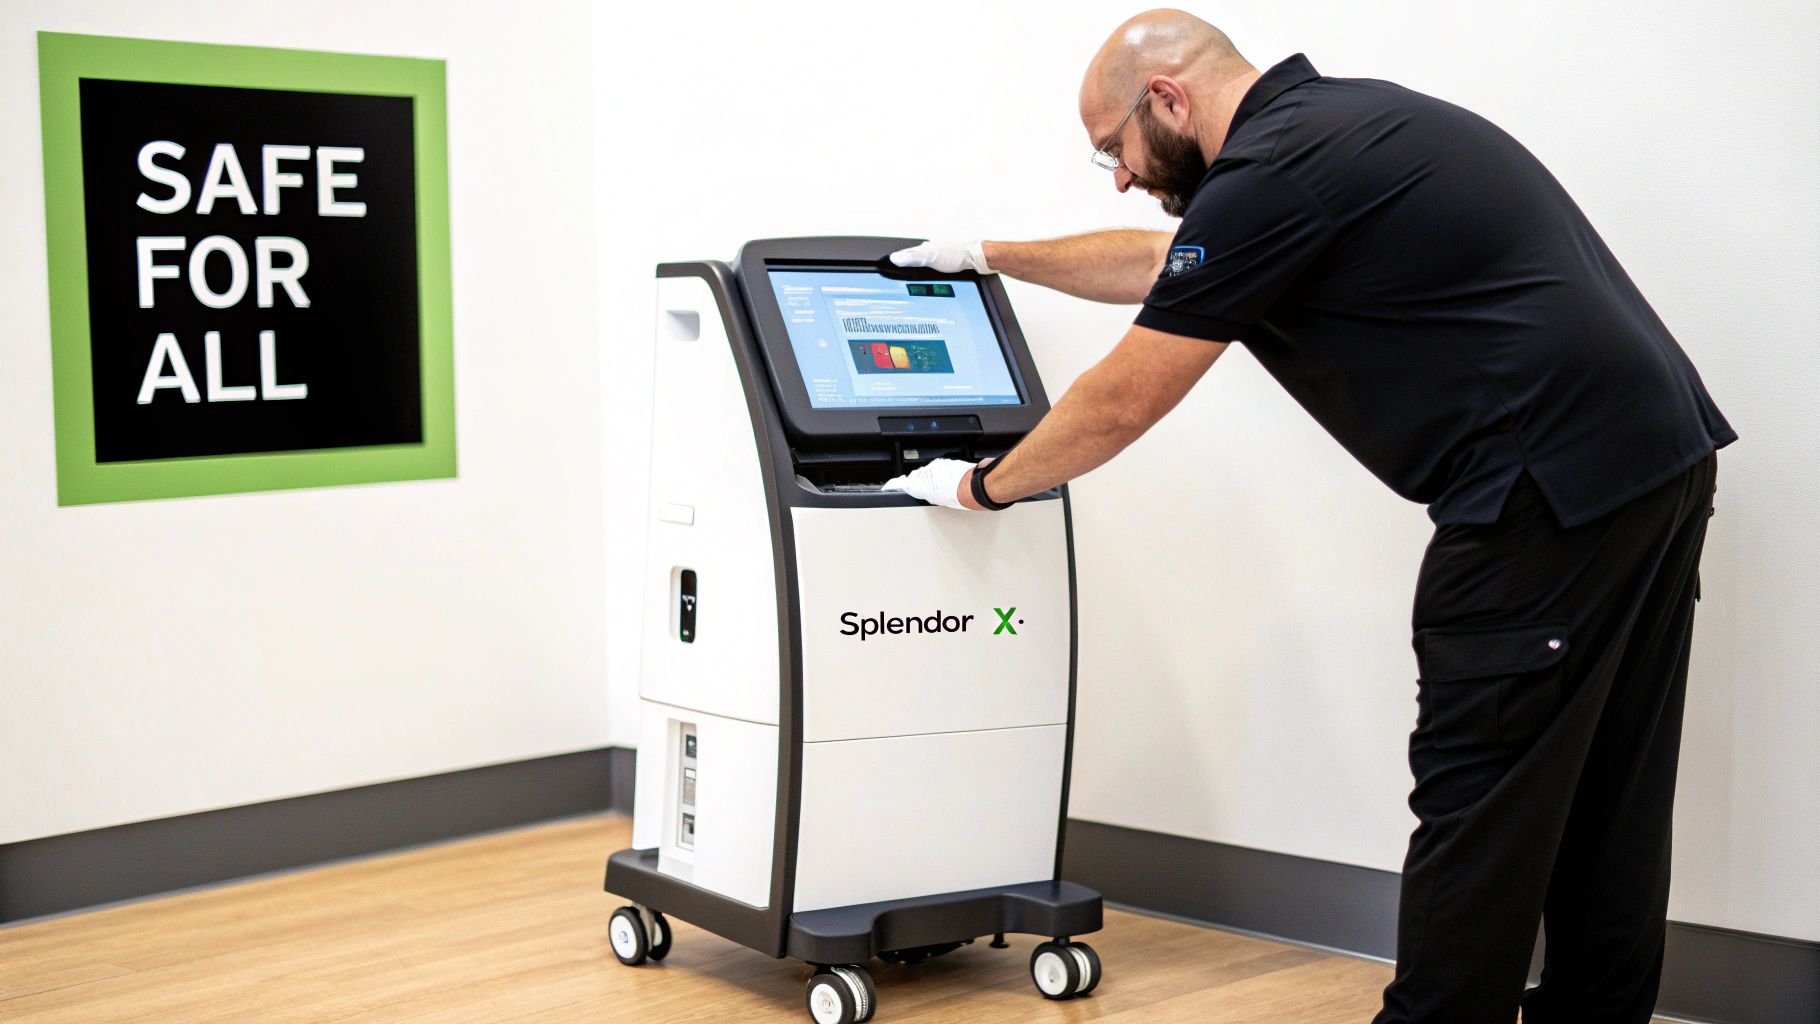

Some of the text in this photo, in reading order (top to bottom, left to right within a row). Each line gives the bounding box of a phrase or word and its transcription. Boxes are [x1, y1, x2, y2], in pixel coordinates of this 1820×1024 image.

[136, 140, 367, 217] SAFE
[136, 235, 311, 309] FOR
[136, 330, 308, 405] ALL
[839, 609, 975, 642] Splendor
